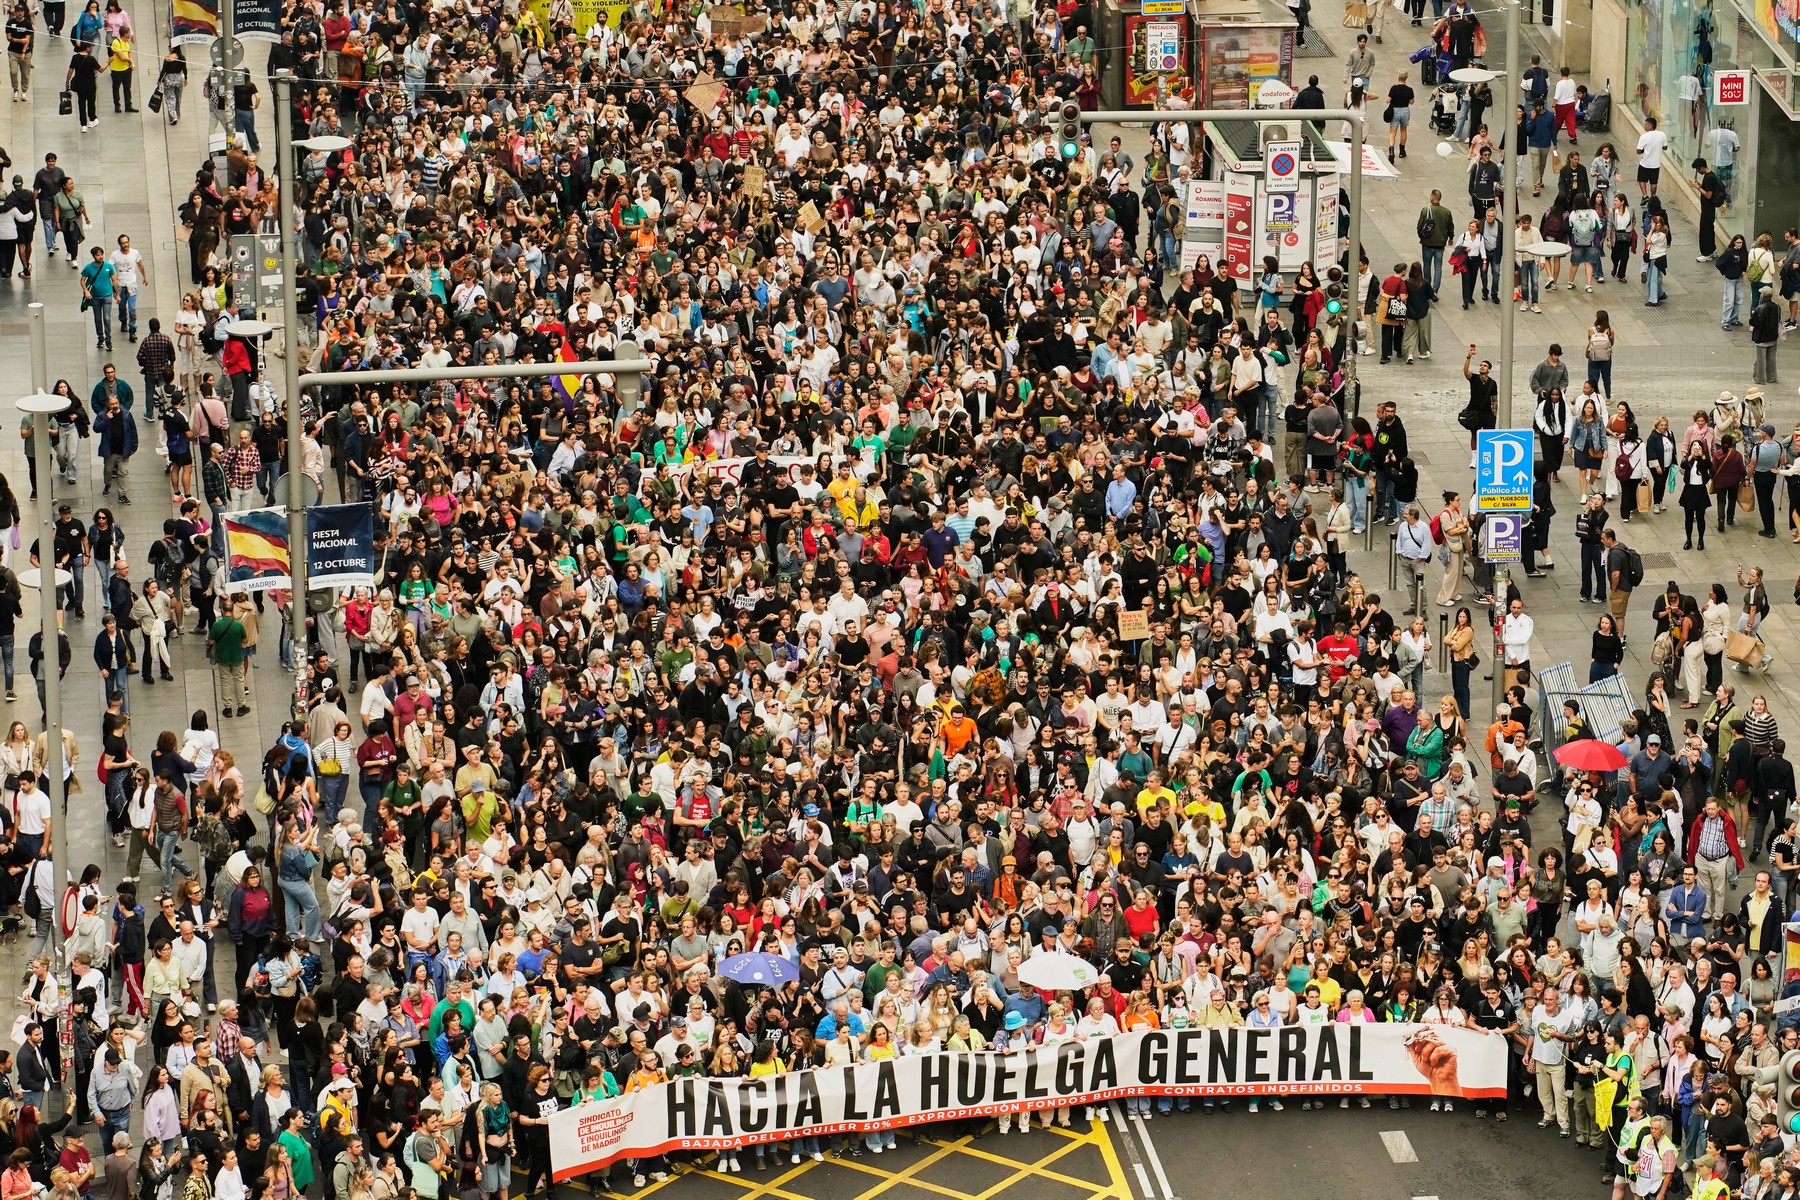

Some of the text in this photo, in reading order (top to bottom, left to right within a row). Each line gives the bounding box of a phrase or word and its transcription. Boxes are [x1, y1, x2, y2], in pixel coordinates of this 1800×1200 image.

[245, 21, 276, 30] OCTUBRE
[1282, 35, 1291, 64] SHAKIRA
[1268, 195, 1289, 221] P
[1489, 440, 1524, 485] P
[313, 529, 339, 539] FIESTA
[1488, 518, 1514, 548] P
[313, 538, 358, 549] NACIONAL
[325, 558, 366, 569] OCTUBRE
[248, 580, 276, 589] MADRID
[667, 1026, 1373, 1138] HACIA LA HUELGA GENERAL
[580, 1108, 621, 1125] SINDICATO
[580, 1114, 632, 1135] DE INQUILINAS
[682, 1138, 743, 1148] BAJADA
[749, 1131, 777, 1142] DEL
[783, 1124, 856, 1138] ALQUILER
[864, 1120, 891, 1130] 50%
[908, 1103, 1014, 1124] EXPROPIACIÓN
[1028, 1096, 1087, 1108] FONDOS
[1093, 1086, 1145, 1100] BUITRE
[1164, 1085, 1252, 1094] CONTRATOS
[1262, 1084, 1363, 1092] INDEFINIDOS
[586, 1125, 627, 1143] INQUILINOS
[593, 1136, 620, 1150] MADRID
